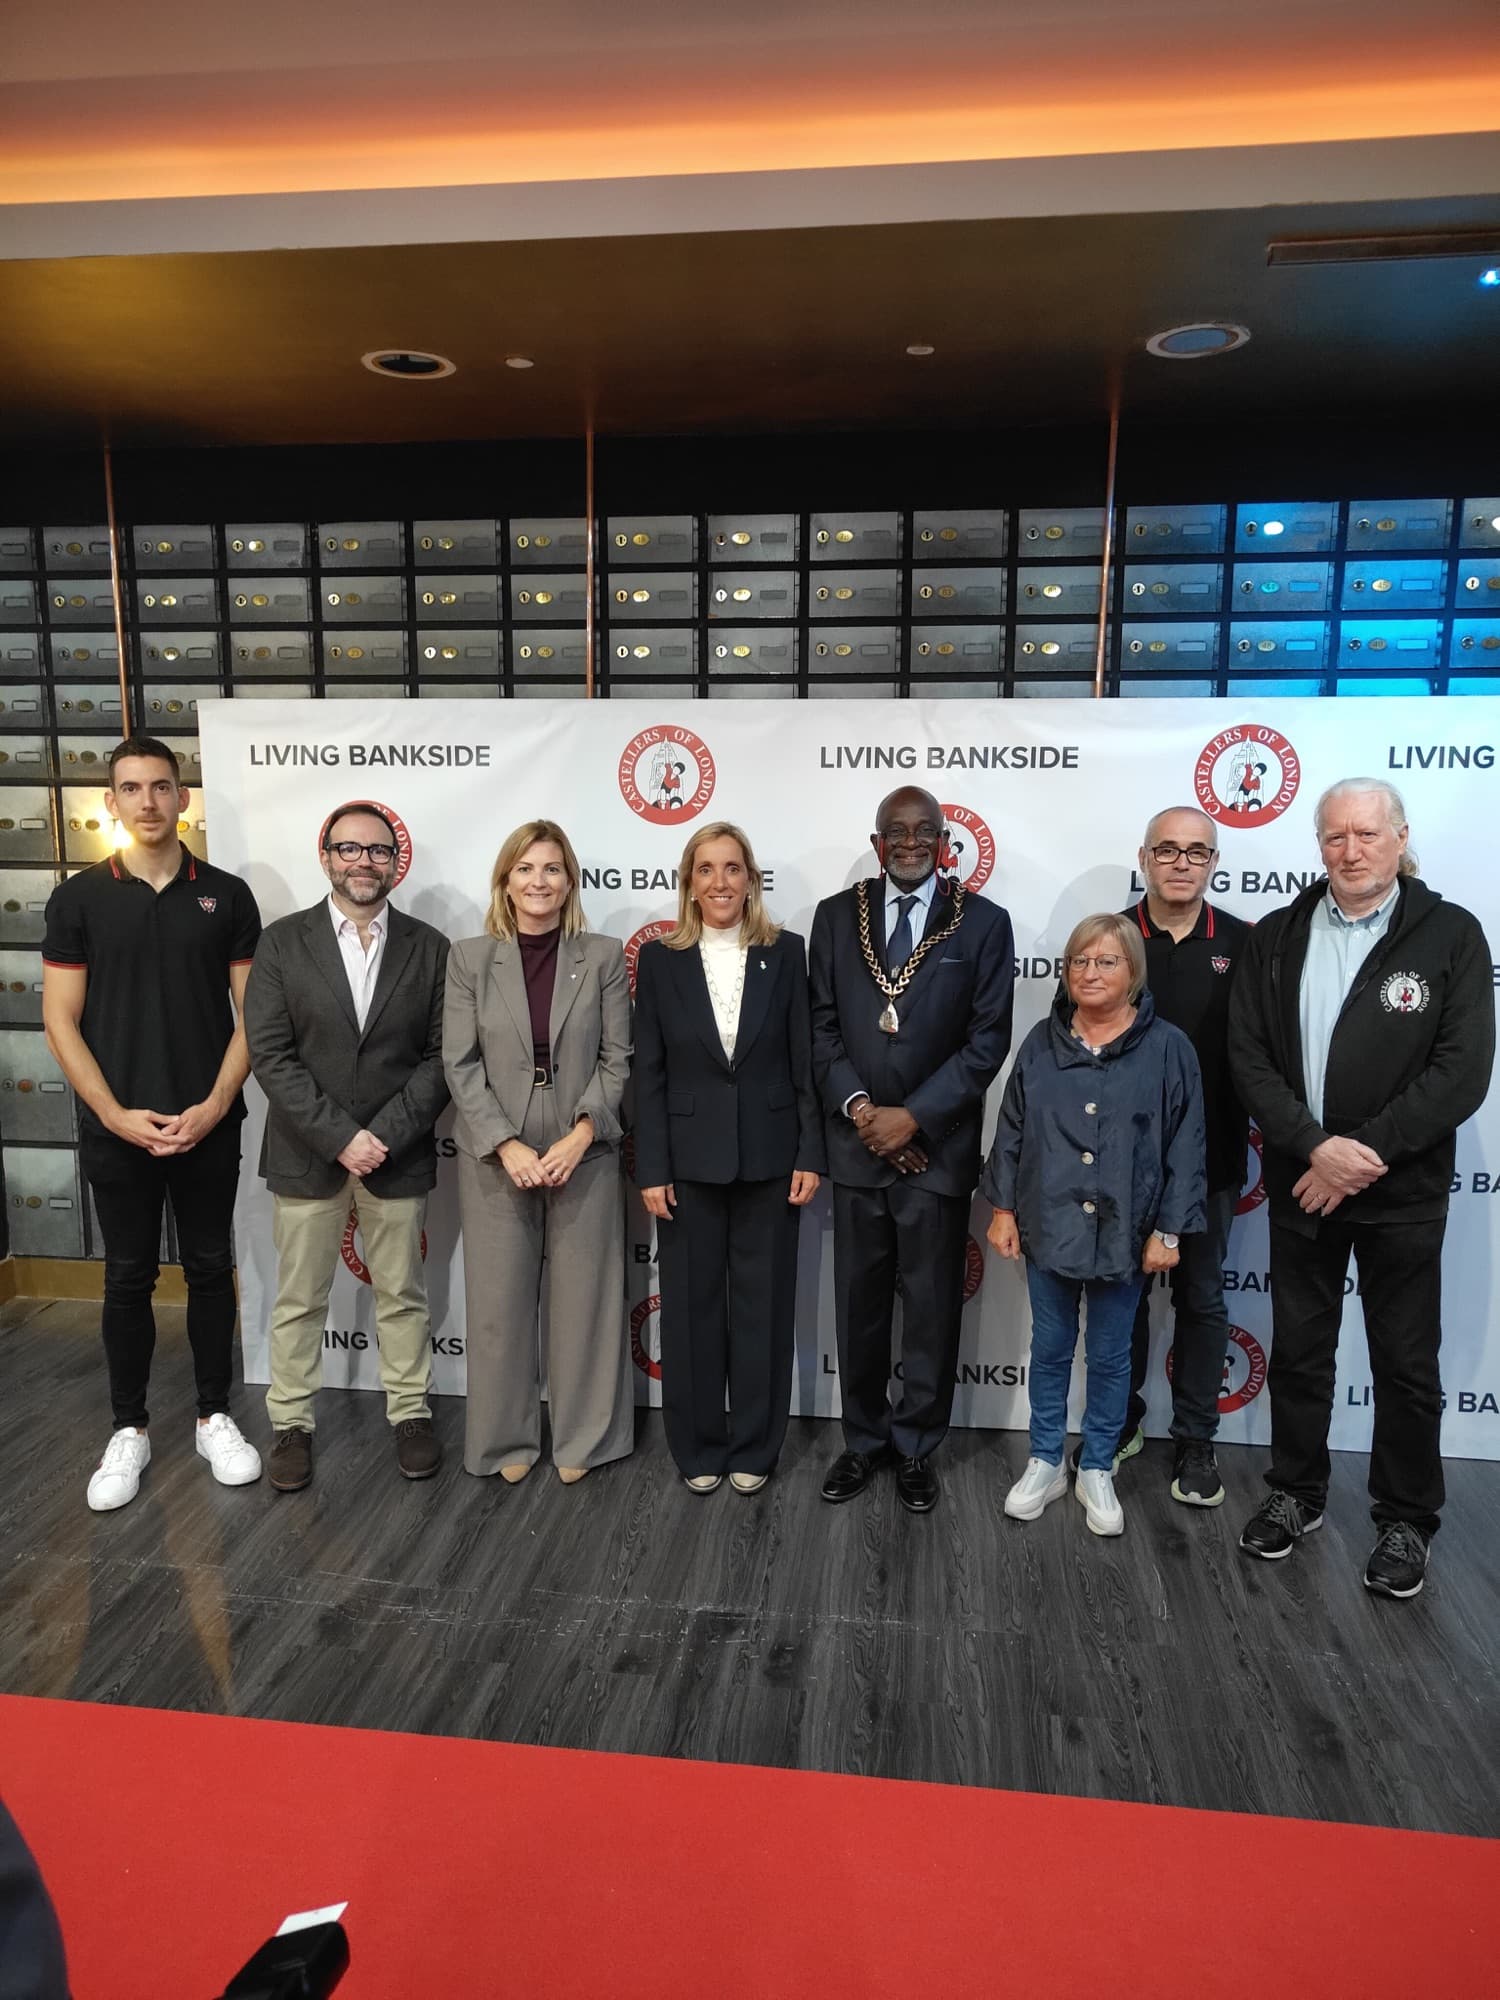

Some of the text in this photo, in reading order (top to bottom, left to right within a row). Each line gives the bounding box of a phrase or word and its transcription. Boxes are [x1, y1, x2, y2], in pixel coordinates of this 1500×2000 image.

[250, 744, 490, 767] LIVING BANKSIDE
[621, 728, 713, 813] CASTELLERS OF LONDON
[820, 746, 1079, 769] LIVING BANKSIDE
[1197, 728, 1298, 815] CASTELLERS OF LONDON
[1388, 745, 1495, 769] LIVING
[953, 808, 993, 890] OF LONDON
[1408, 971, 1420, 980] OF
[1416, 979, 1430, 1013] LONDON
[1228, 1327, 1264, 1402] OF LONDON
